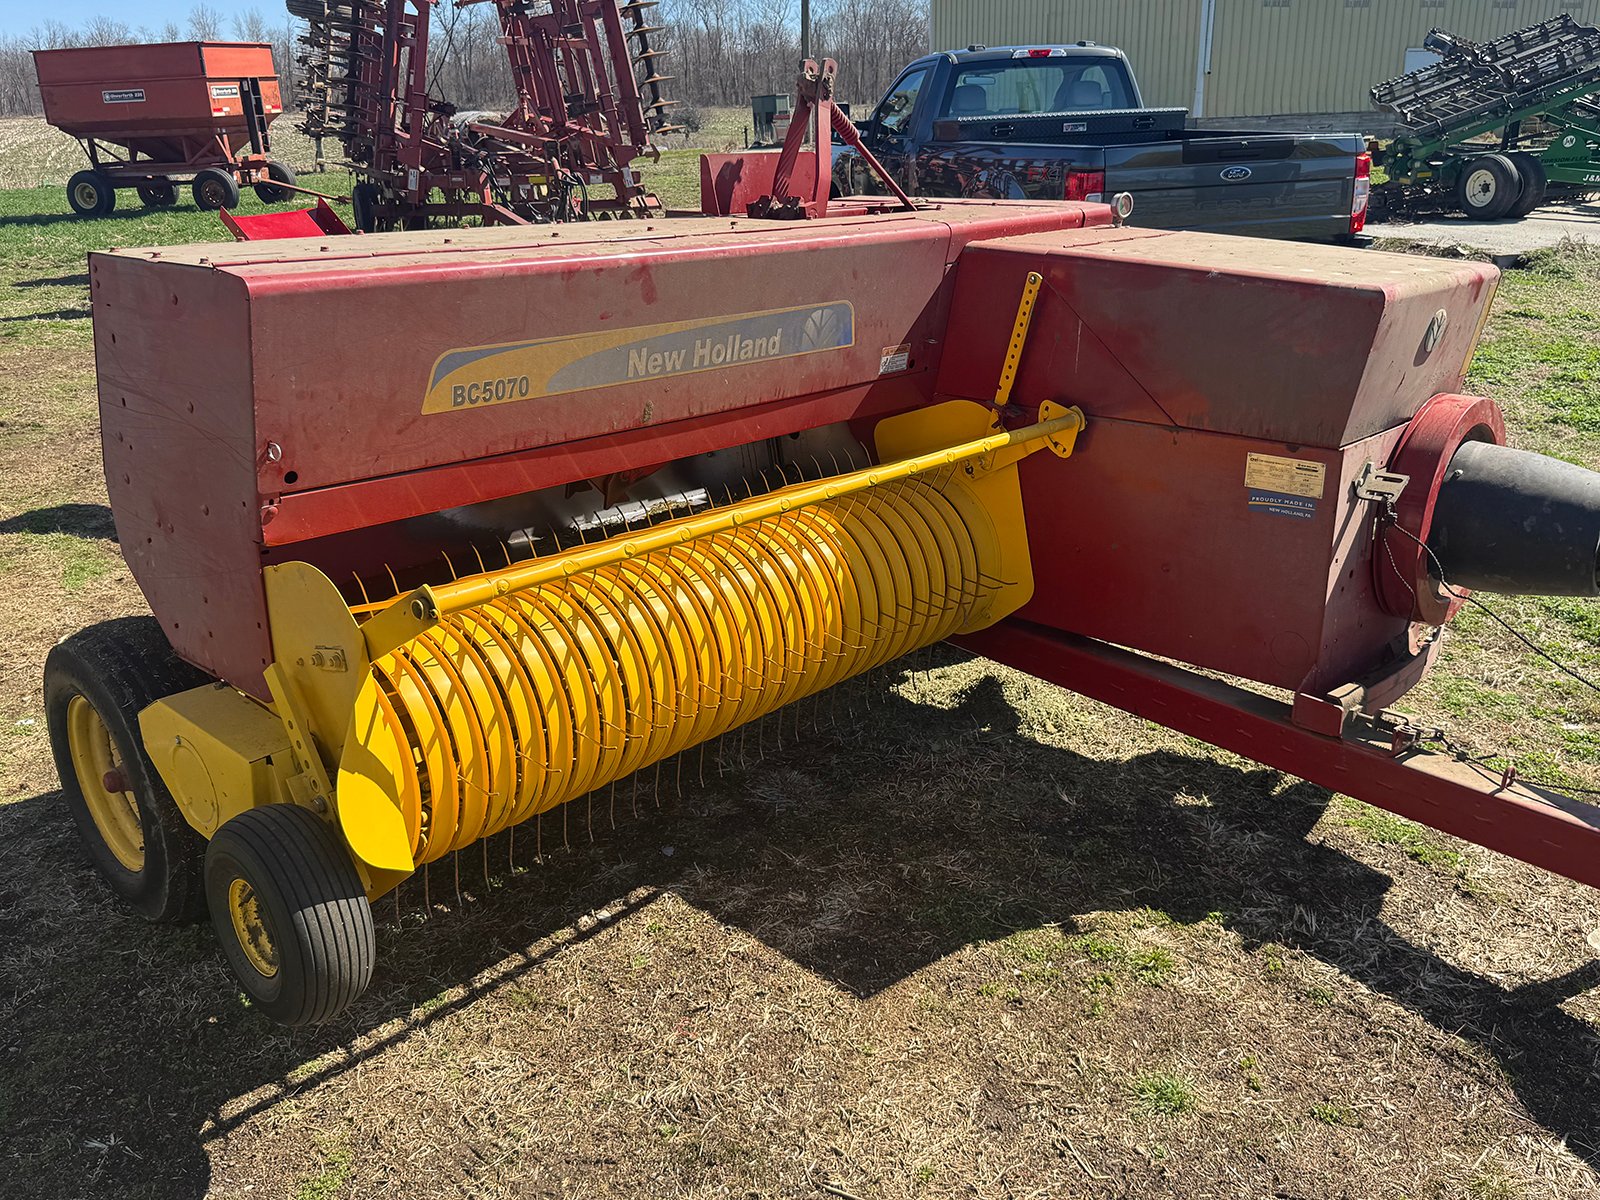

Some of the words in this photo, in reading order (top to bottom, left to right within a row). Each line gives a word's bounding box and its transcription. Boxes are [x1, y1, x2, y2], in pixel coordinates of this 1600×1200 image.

[1027, 165, 1061, 183] FX4
[626, 346, 687, 379] New
[692, 327, 783, 369] Holland
[451, 375, 530, 408] BC5070
